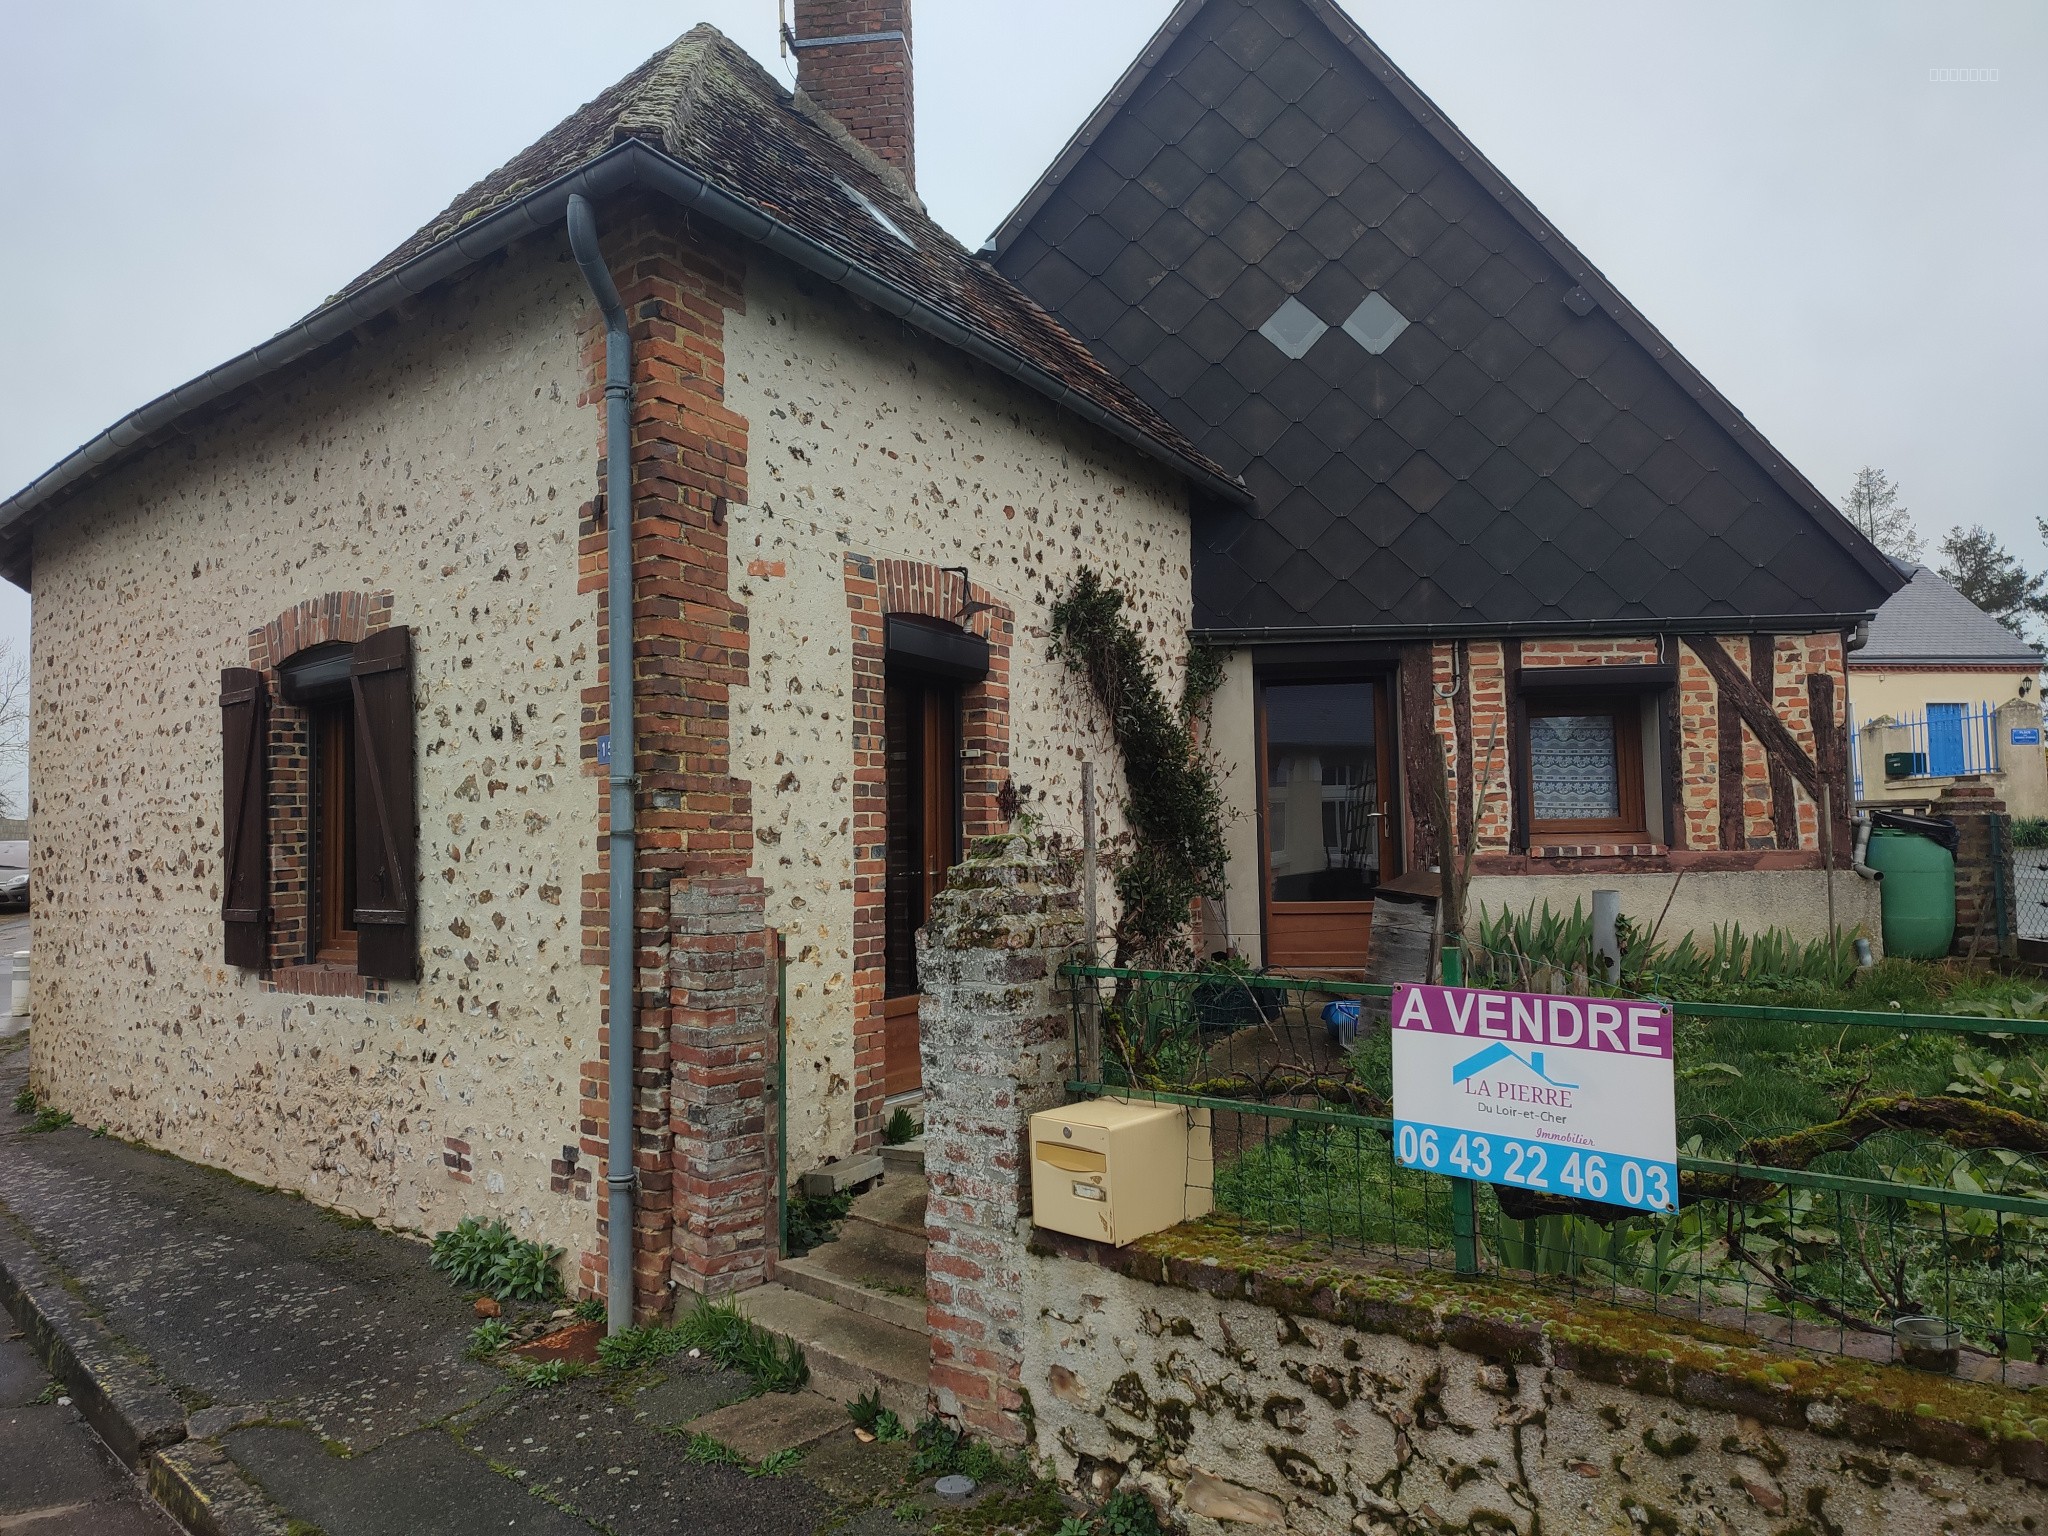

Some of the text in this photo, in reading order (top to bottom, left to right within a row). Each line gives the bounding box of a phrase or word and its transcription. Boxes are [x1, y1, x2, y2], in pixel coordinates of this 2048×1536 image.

[1399, 987, 1662, 1056] A VENDRE
[1465, 1077, 1573, 1109] LA PIERRE
[1478, 1102, 1567, 1124] Du Loir-et-Cher
[1535, 1127, 1595, 1146] Immobilier
[1399, 1125, 1670, 1209] 06 43 22 46 03
